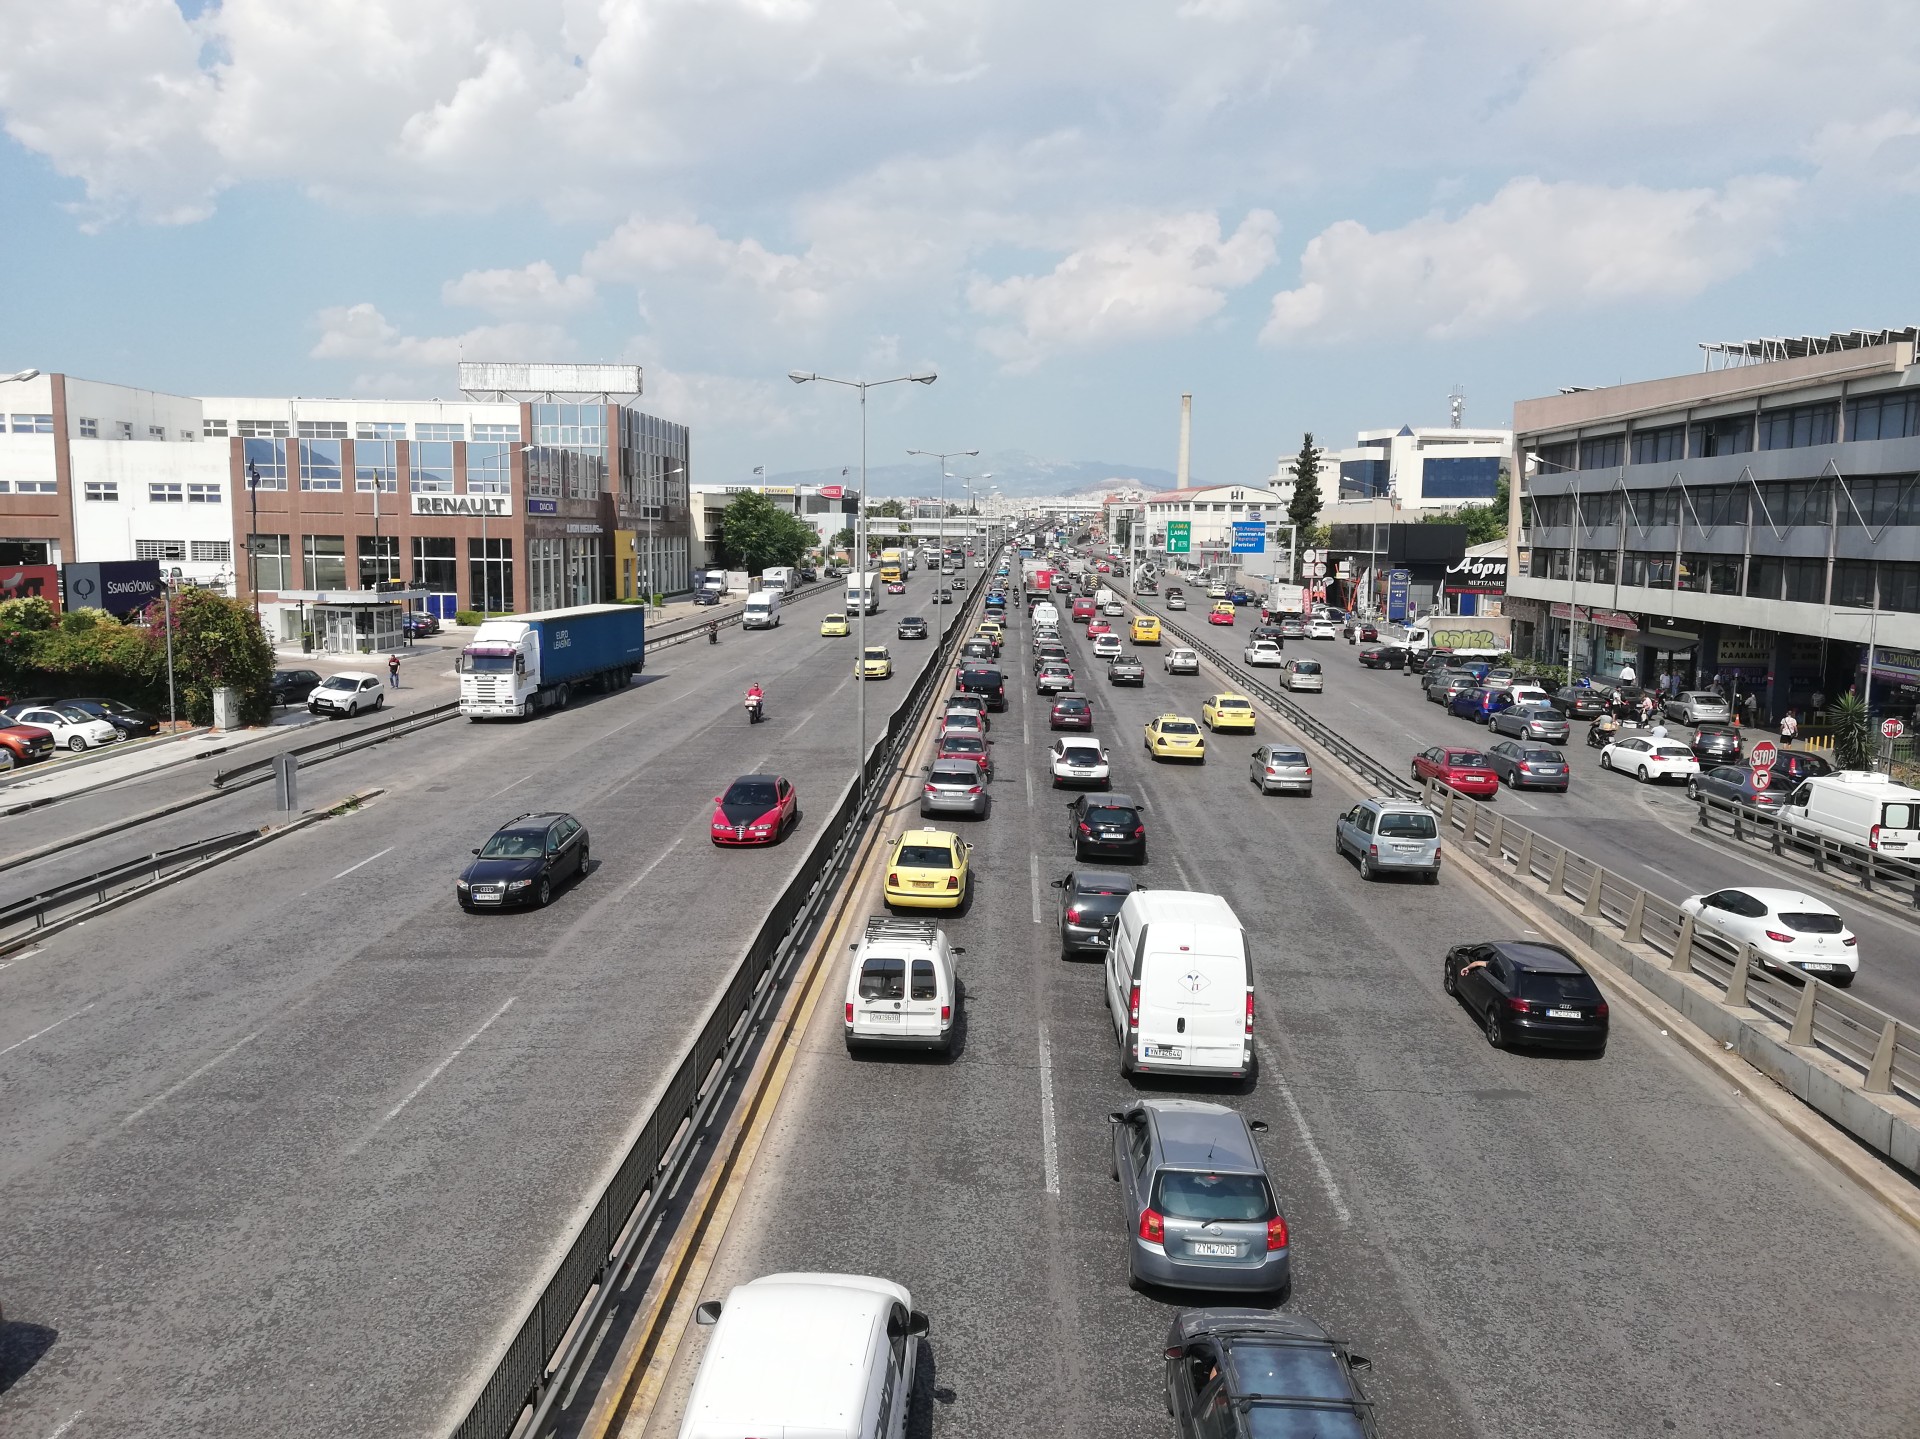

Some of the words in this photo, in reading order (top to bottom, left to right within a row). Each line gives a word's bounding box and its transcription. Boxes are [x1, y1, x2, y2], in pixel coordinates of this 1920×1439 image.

[417, 497, 506, 514] RENAULT
[539, 502, 554, 512] DACIA
[556, 629, 568, 640] EURO
[553, 638, 572, 650] LEASING
[1883, 723, 1901, 734] STOP
[1752, 749, 1775, 766] STOP
